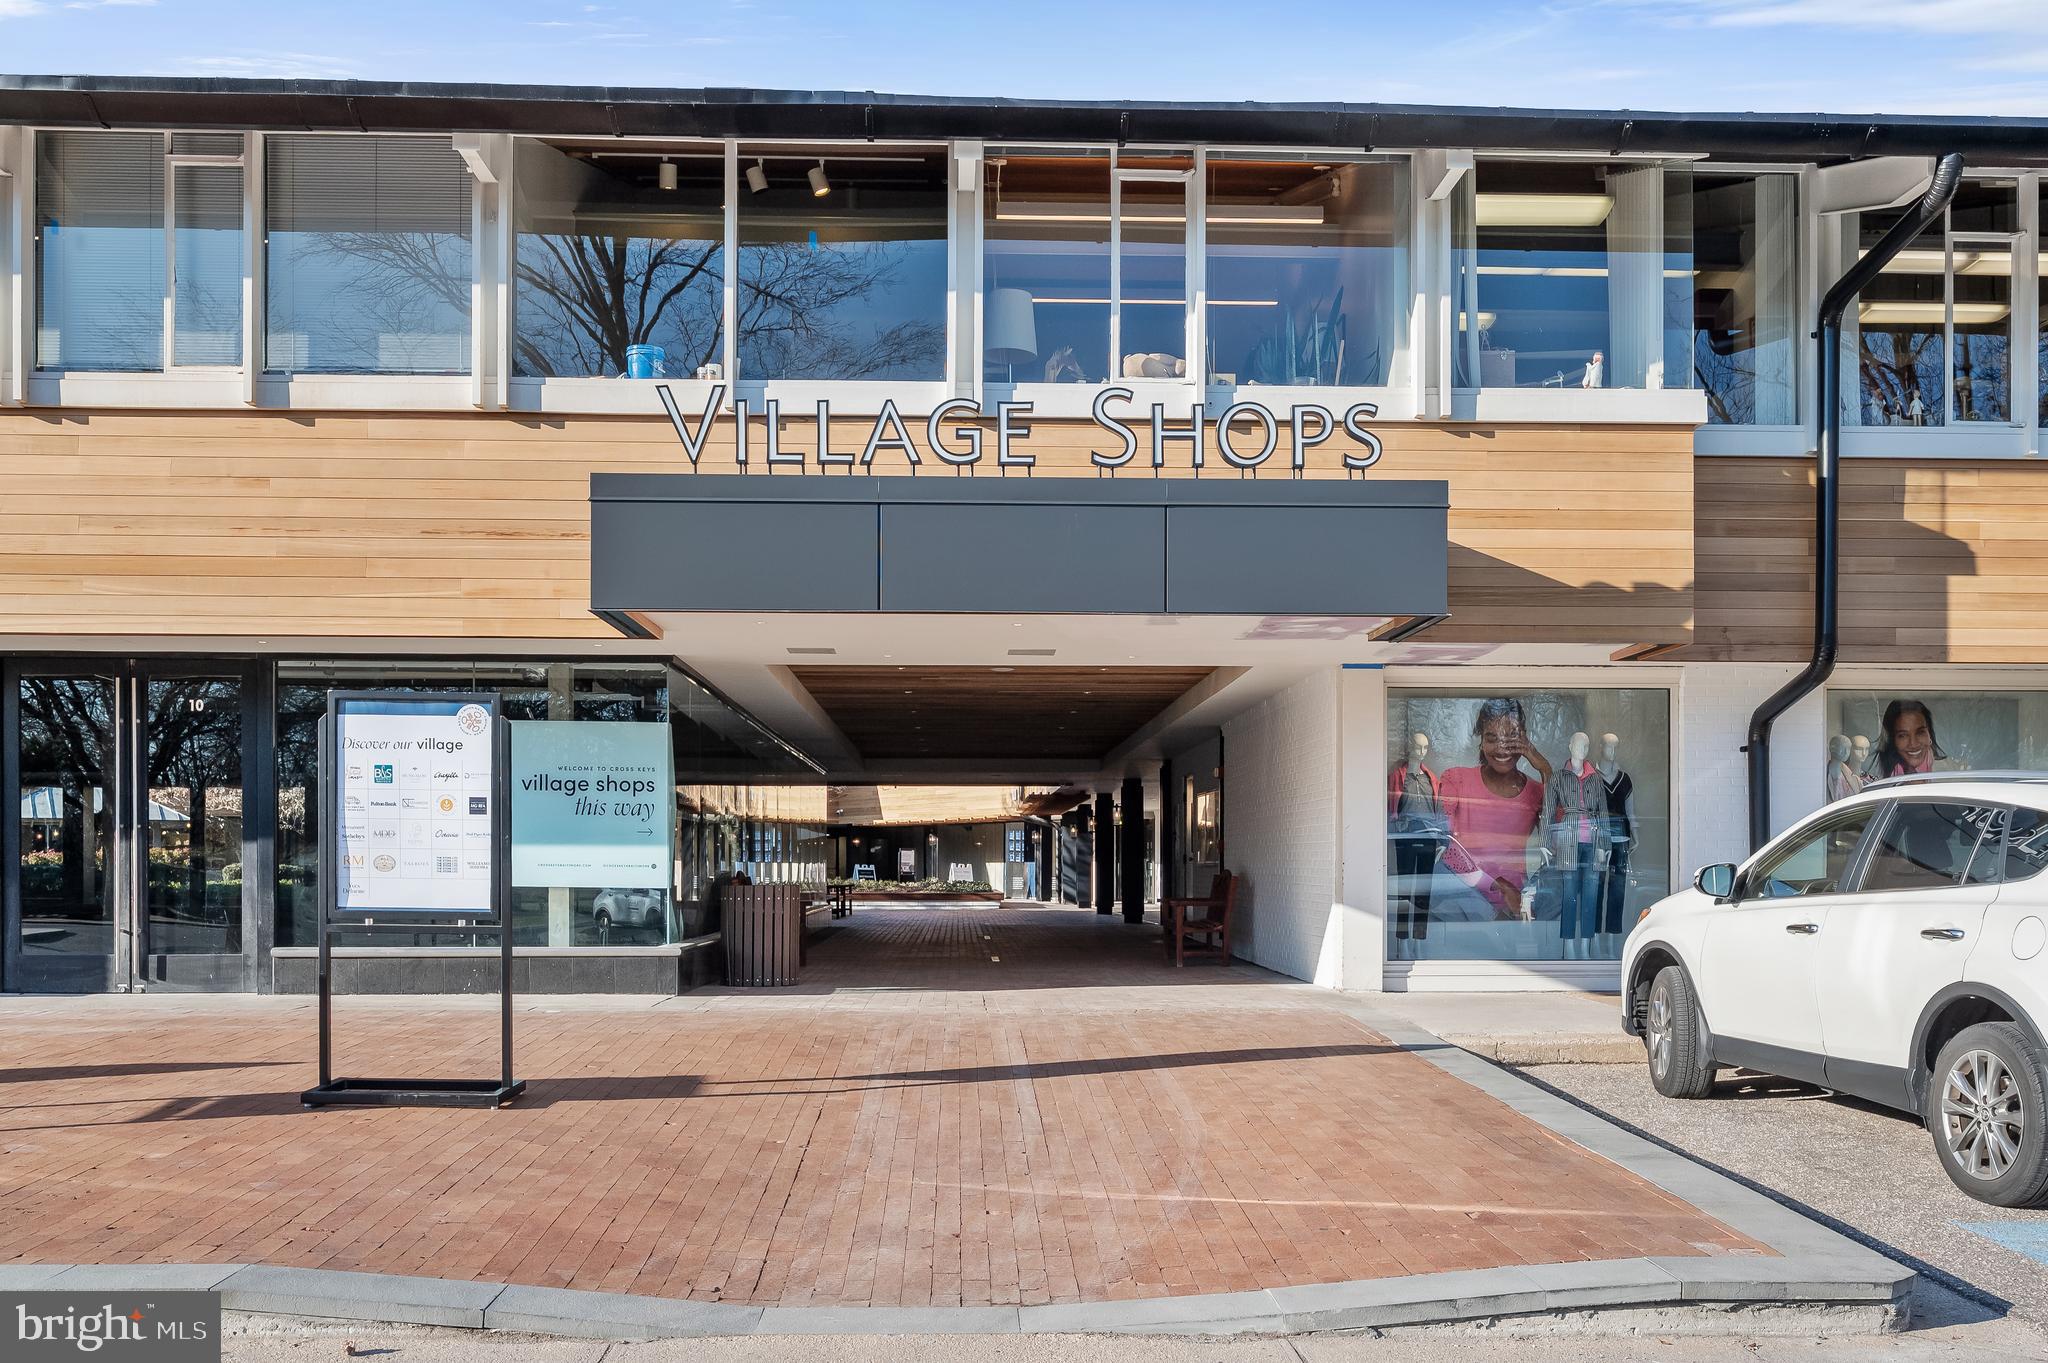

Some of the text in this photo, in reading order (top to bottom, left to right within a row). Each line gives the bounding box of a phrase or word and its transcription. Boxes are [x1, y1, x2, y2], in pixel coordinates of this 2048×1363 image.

[655, 384, 1384, 470] VILLAGE SHOPS
[188, 699, 205, 712] 10
[341, 736, 464, 754] Discover our village
[521, 773, 656, 797] village shops
[574, 795, 655, 822] this way
